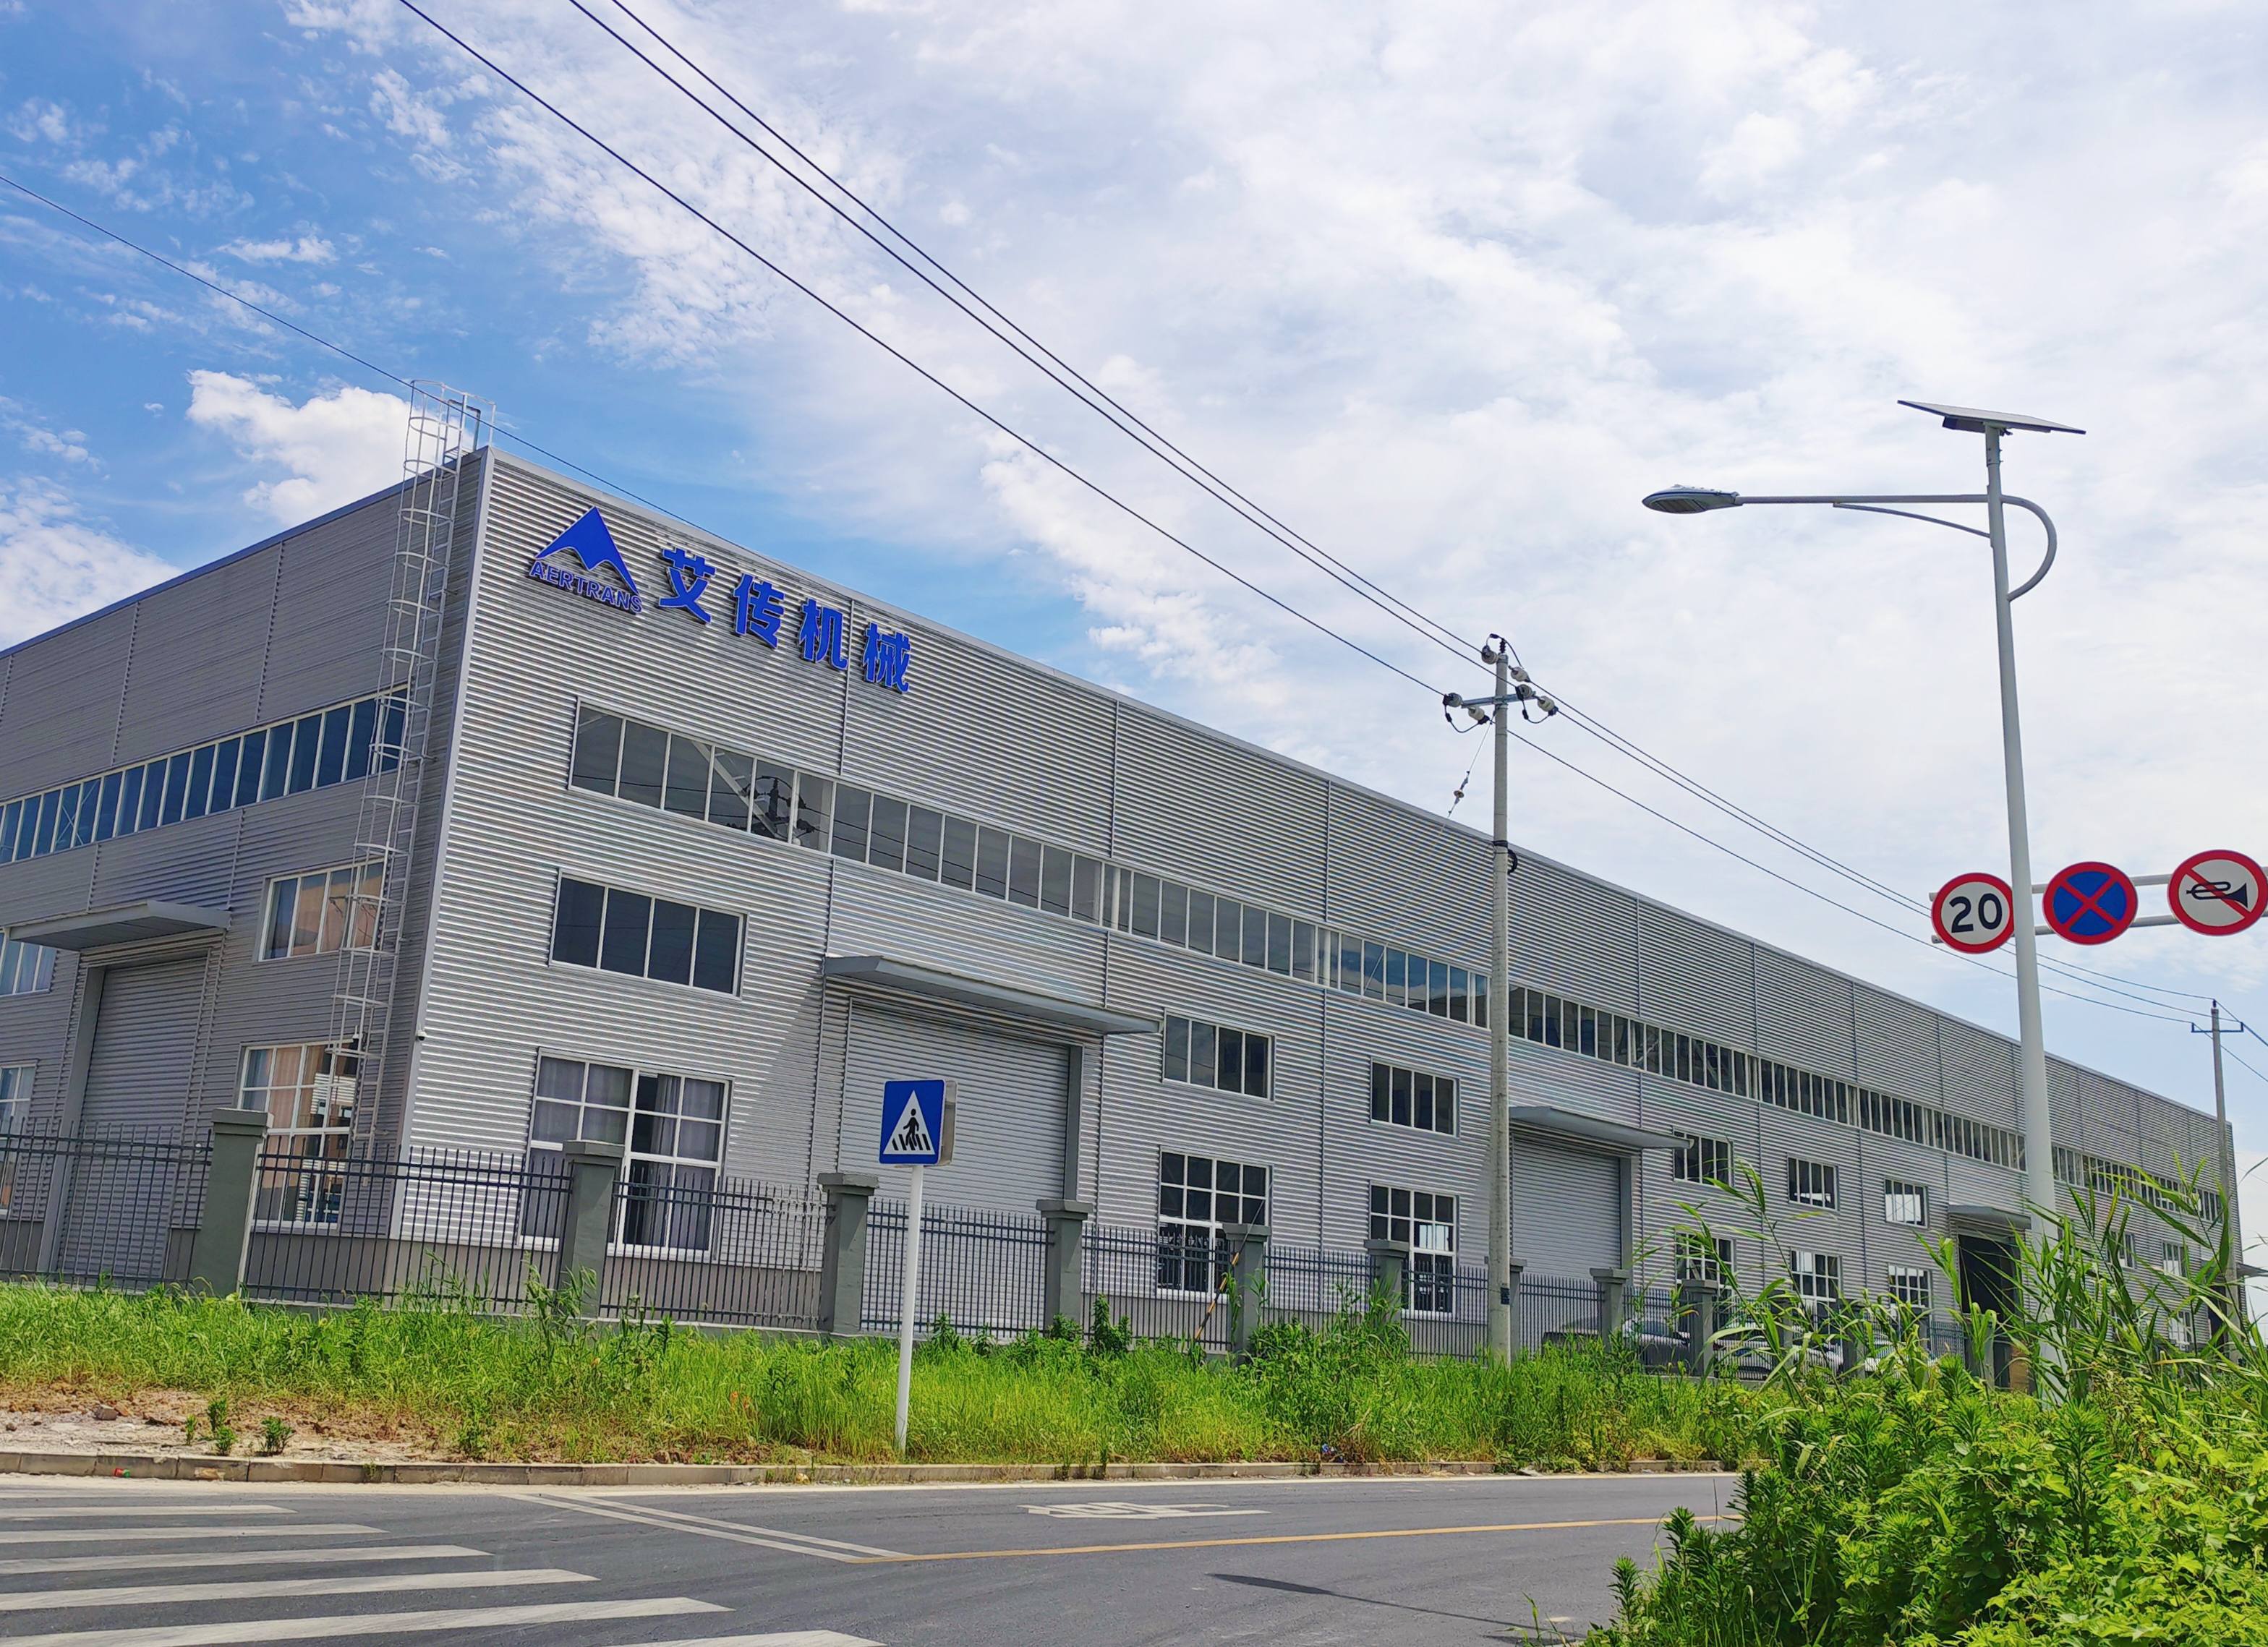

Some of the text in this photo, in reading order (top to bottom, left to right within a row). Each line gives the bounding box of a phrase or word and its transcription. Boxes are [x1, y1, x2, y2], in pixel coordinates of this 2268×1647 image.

[530, 560, 642, 613] AERTRANS
[659, 547, 911, 693] 艾传机械
[1949, 894, 2003, 933] 20
